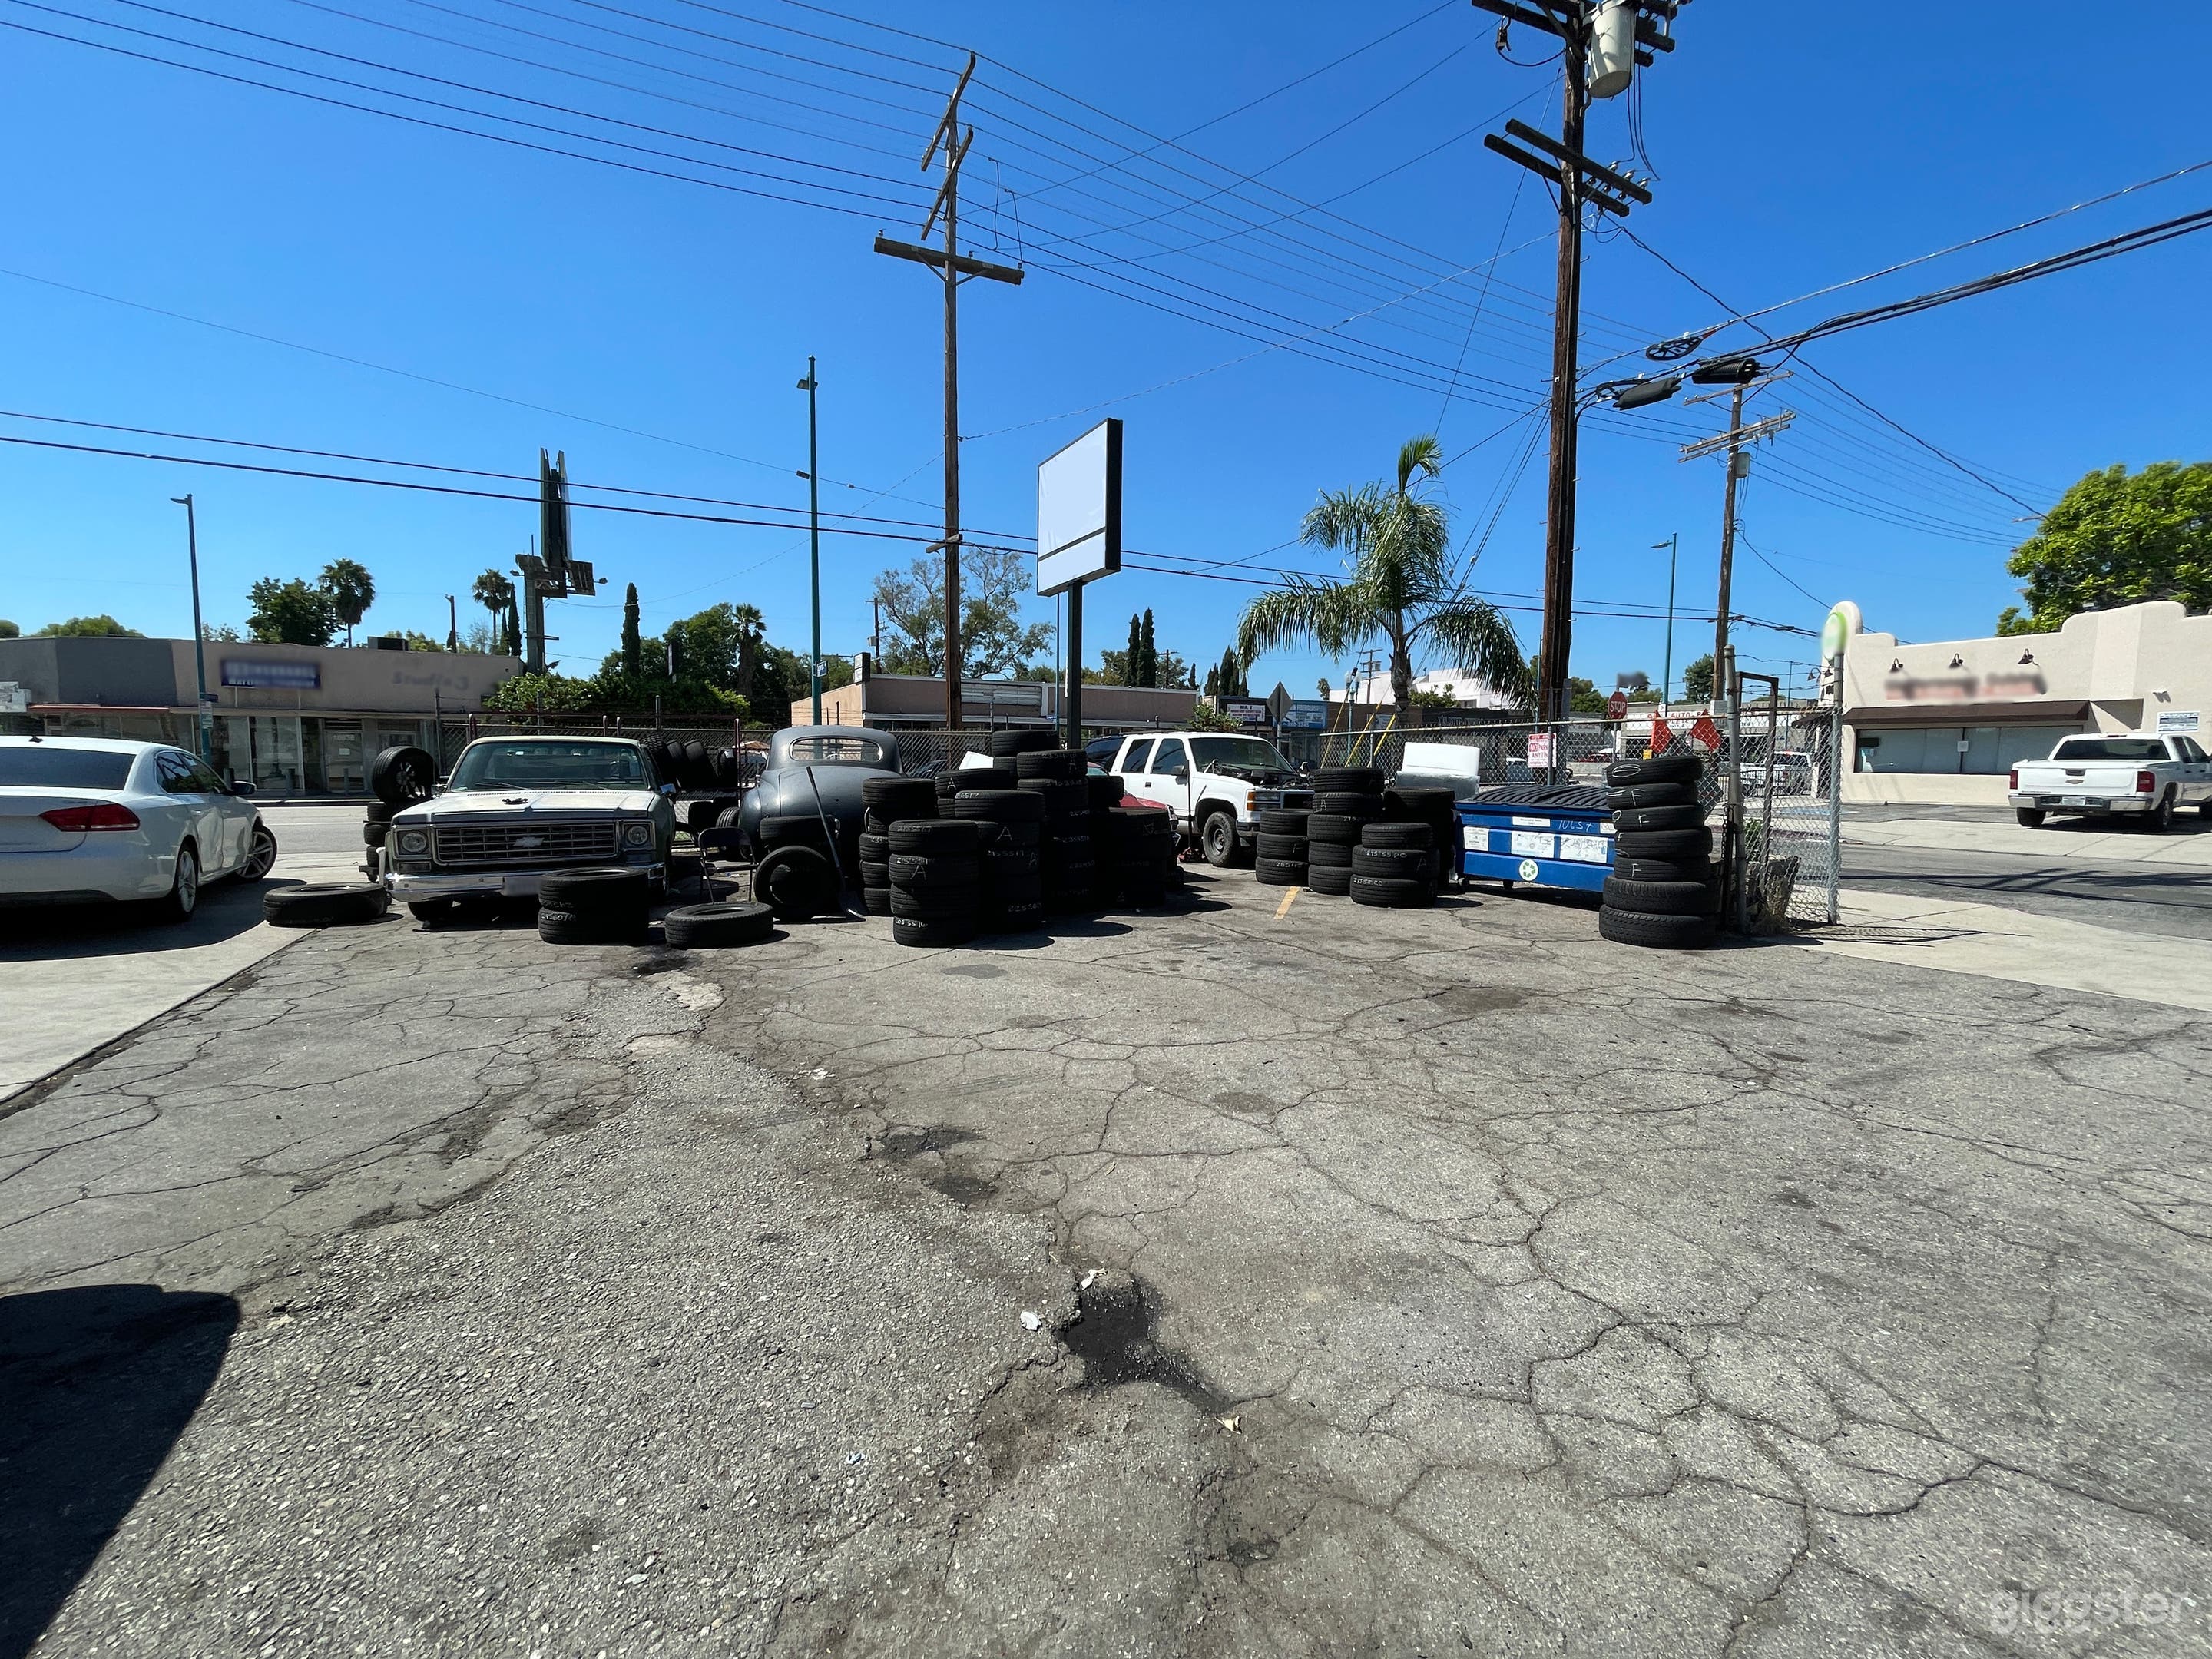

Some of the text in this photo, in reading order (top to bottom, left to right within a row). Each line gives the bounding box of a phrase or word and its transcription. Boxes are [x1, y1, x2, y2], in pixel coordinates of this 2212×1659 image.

[1610, 700, 1626, 713] STOP
[946, 777, 956, 791] A
[996, 826, 1013, 841] A
[910, 865, 926, 880] A
